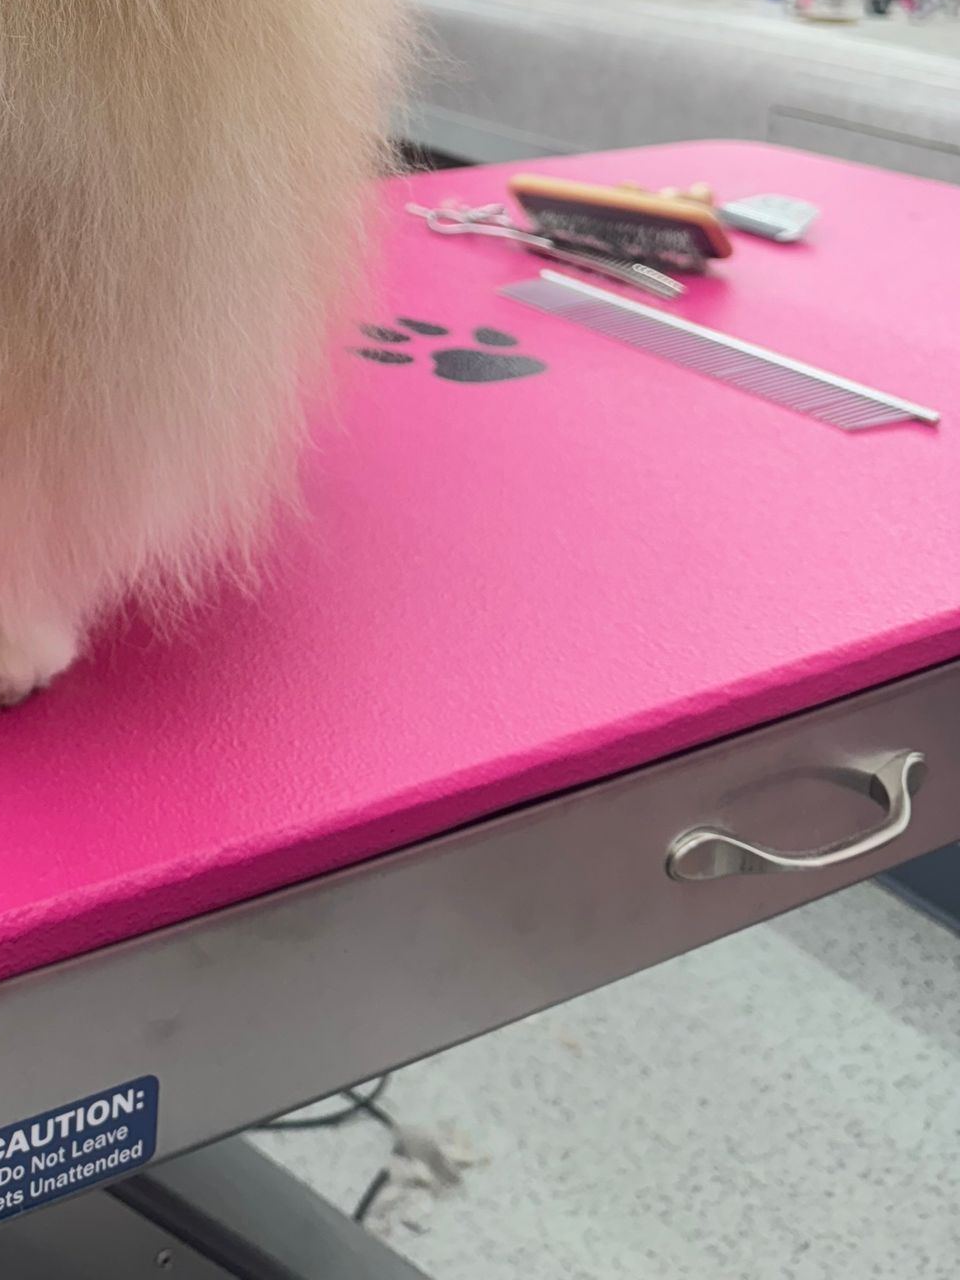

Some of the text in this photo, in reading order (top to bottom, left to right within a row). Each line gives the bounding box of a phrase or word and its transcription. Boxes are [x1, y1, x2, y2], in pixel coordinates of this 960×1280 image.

[30, 1140, 143, 1198] Unattended
[31, 1147, 66, 1173] Not
[71, 1126, 129, 1158] Leave
